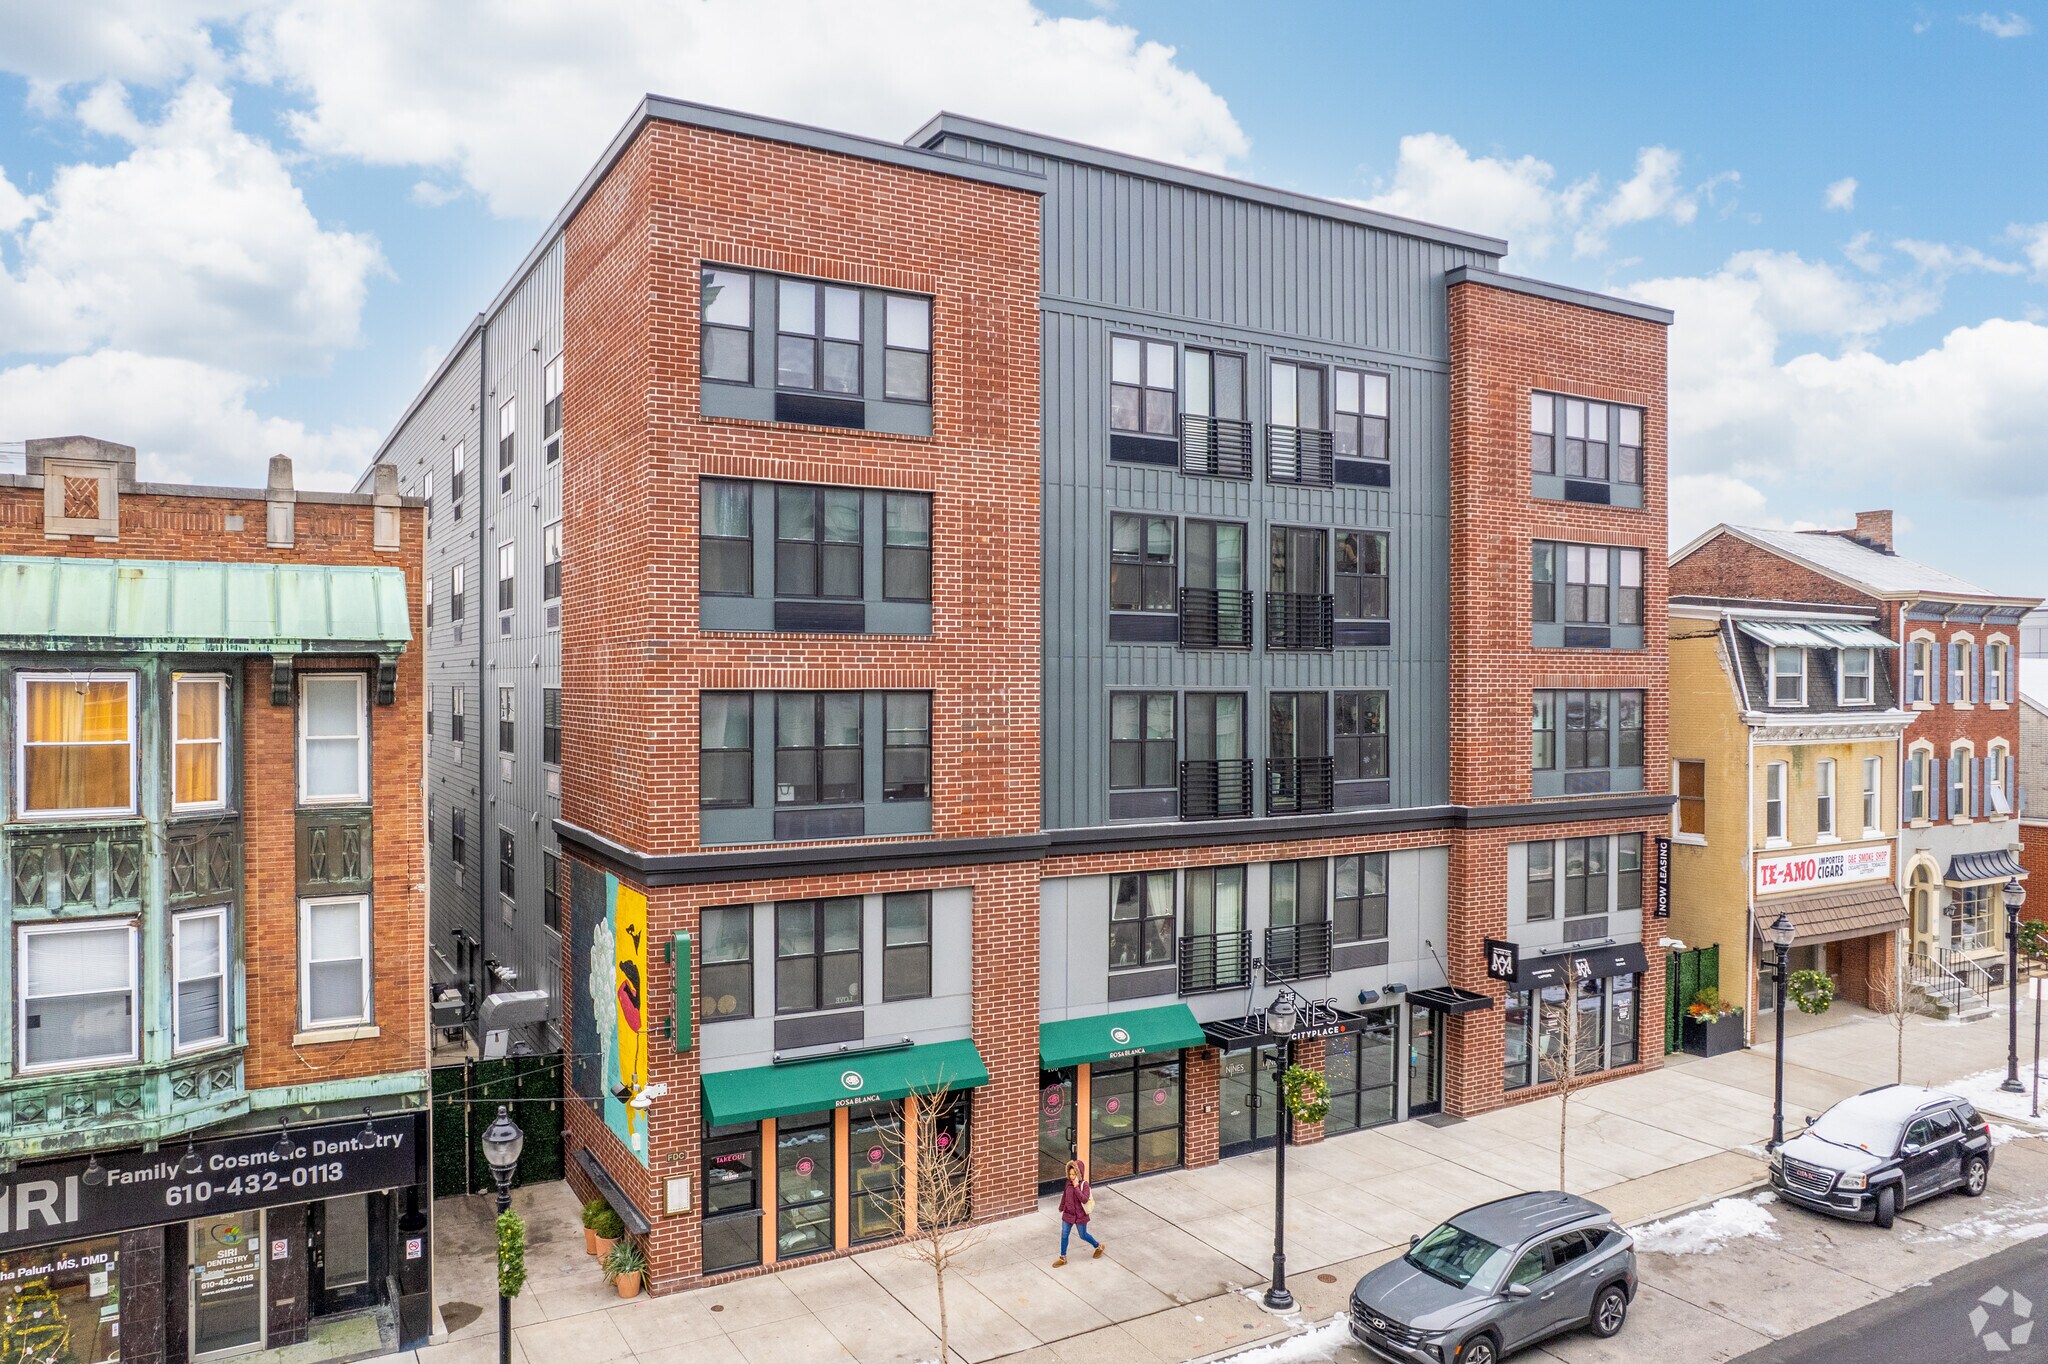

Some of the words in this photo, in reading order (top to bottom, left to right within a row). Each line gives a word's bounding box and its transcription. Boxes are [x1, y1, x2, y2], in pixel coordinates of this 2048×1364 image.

[1660, 842, 1668, 884] LEASING
[1818, 855, 1845, 865] IMPORTED
[1761, 859, 1816, 886] TE-AMO
[1817, 864, 1844, 879] CIGARS
[1659, 886, 1667, 916] NOW
[1291, 1026, 1339, 1040] CITYPLACE
[1109, 1051, 1125, 1059] ROSA
[1125, 1047, 1146, 1056] BLANCA
[835, 1098, 854, 1107] ROSA
[854, 1095, 881, 1104] BLANCA
[107, 1162, 180, 1187] Family
[313, 1133, 404, 1157] Denttry
[667, 1152, 685, 1162] FDC
[1796, 1169, 1818, 1181] GMC
[165, 1162, 343, 1206] 610-432-0113
[81, 1253, 108, 1266] DMD
[217, 1248, 238, 1259] SIRI
[206, 1255, 248, 1268] DENTISTRY
[201, 1274, 254, 1290] 610-432-0113
